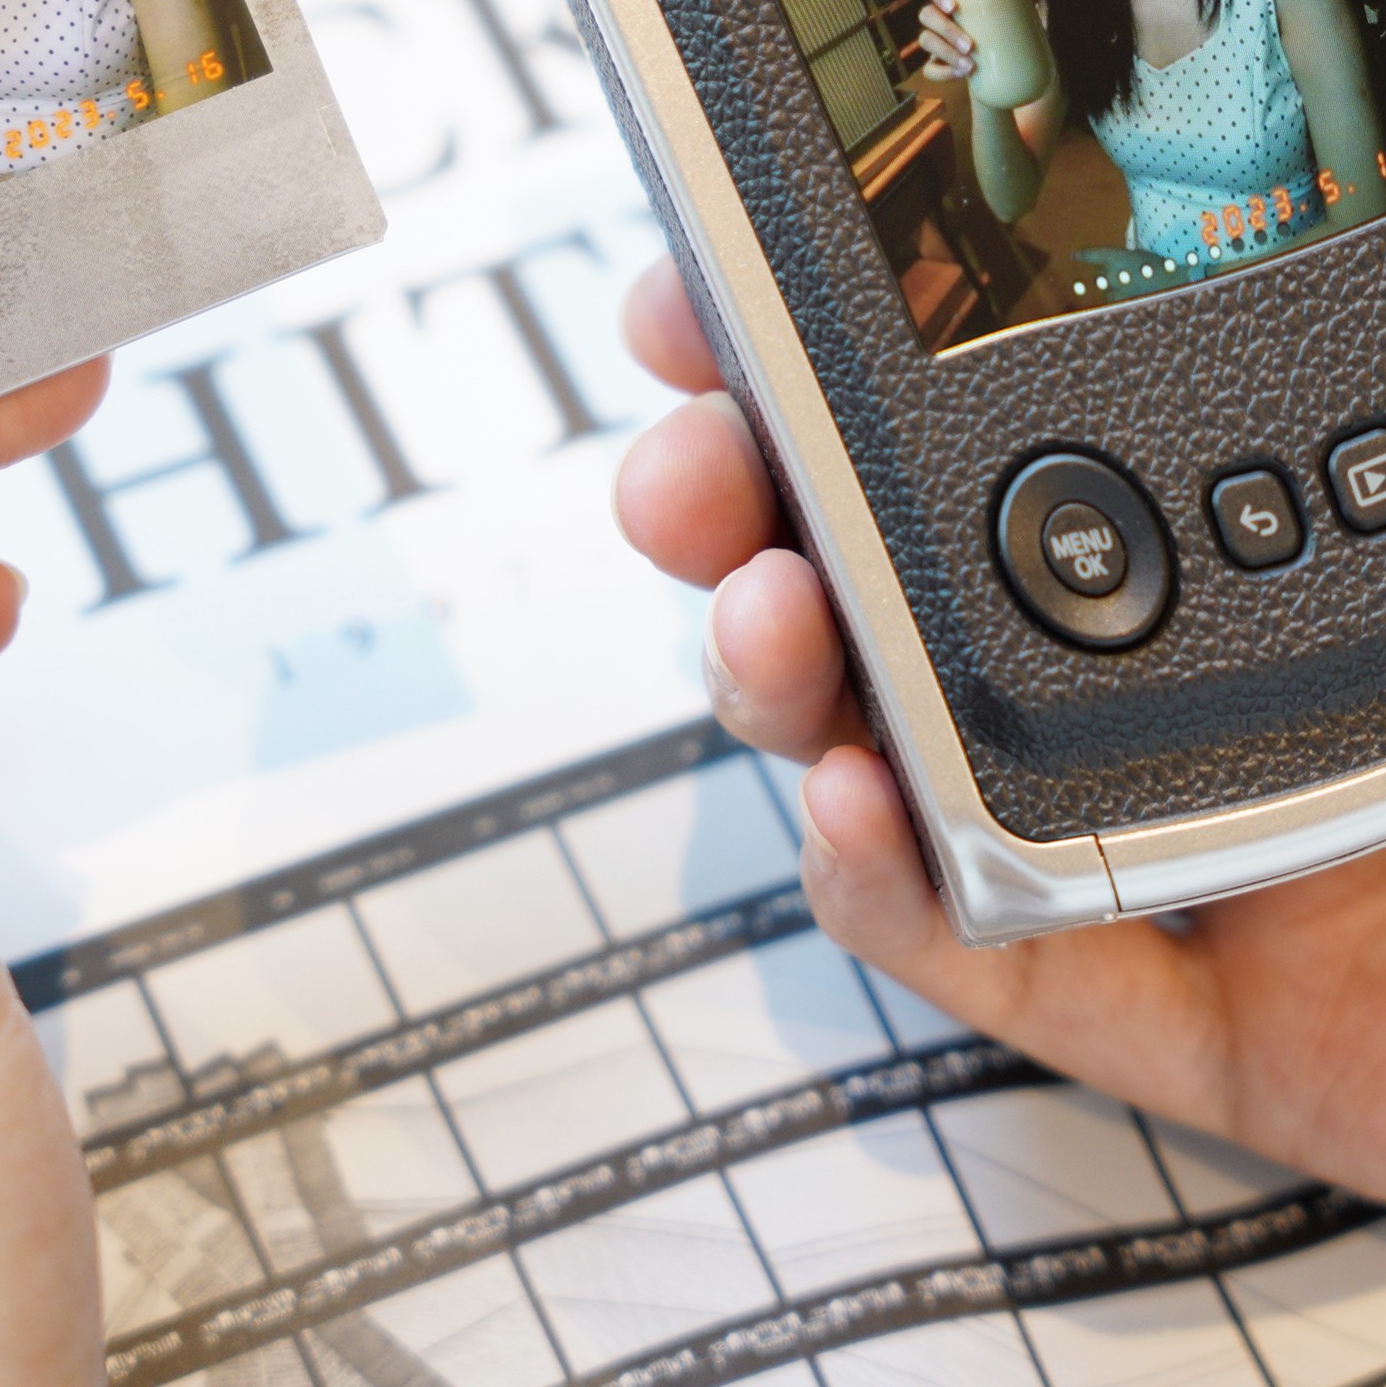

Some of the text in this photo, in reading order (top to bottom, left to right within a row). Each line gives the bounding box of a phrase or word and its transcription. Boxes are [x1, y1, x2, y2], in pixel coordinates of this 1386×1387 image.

[185, 49, 225, 86] 16
[37, 219, 658, 612] HIT
[1050, 525, 1113, 561] MENU
[1074, 551, 1110, 581] OK
